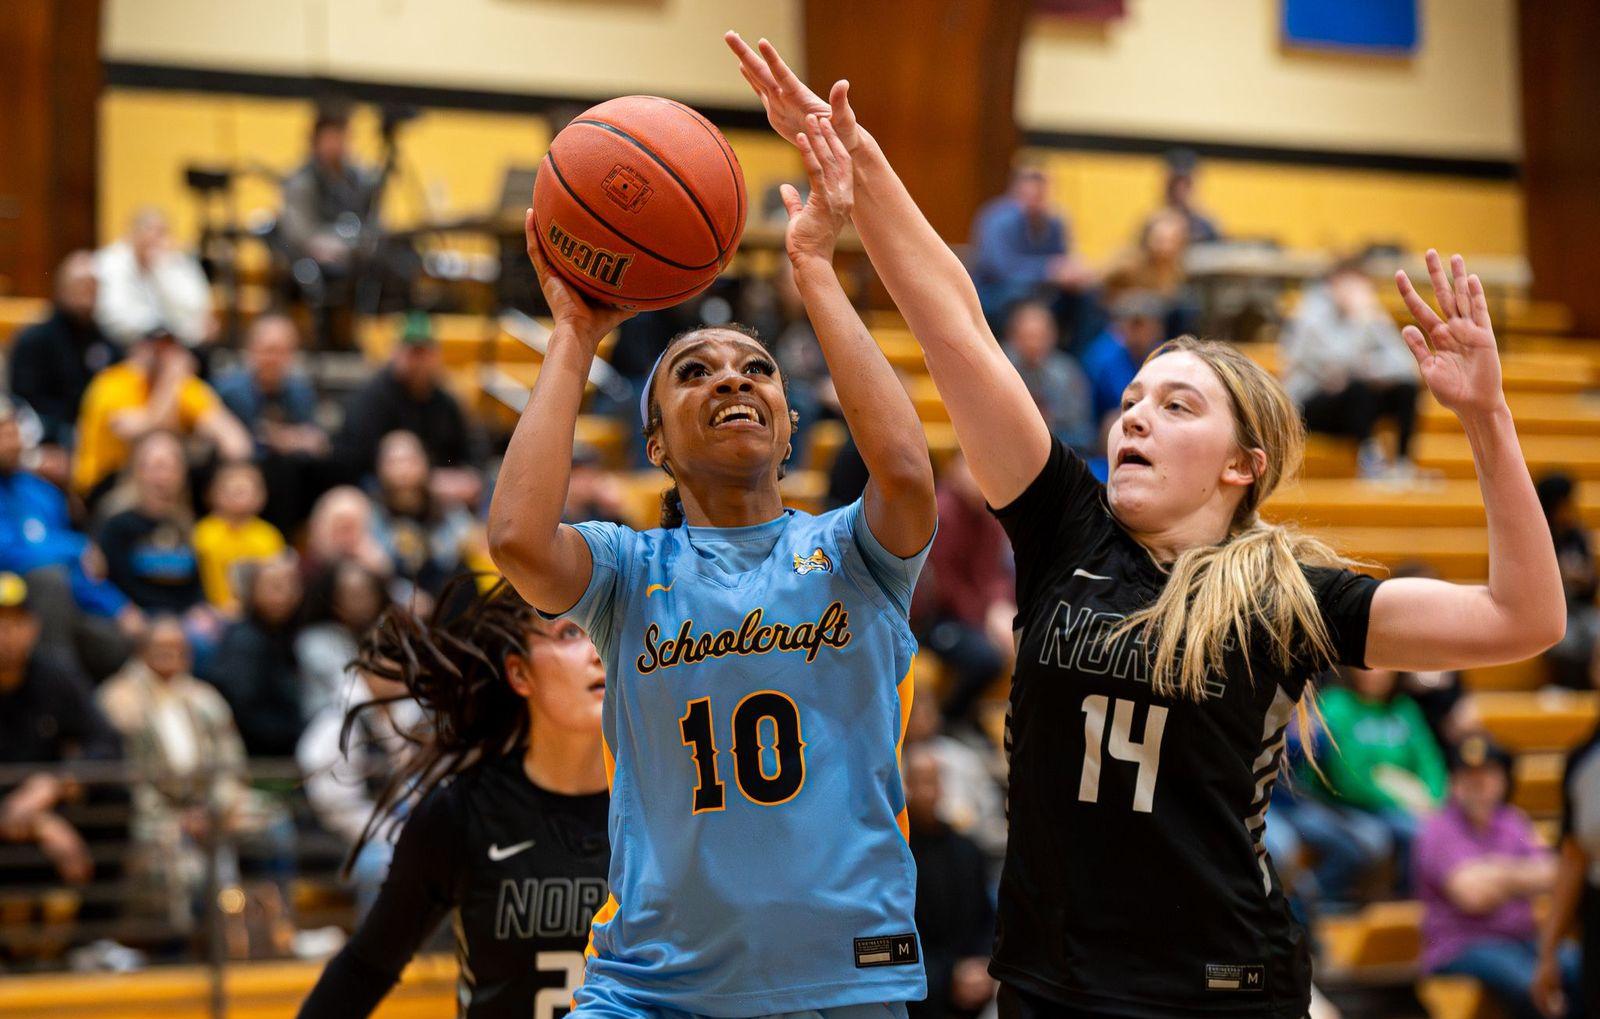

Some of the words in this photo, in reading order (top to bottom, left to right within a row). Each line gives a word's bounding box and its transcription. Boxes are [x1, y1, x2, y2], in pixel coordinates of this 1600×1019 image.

[548, 221, 632, 288] NJCAA
[636, 600, 852, 675] Schoolcraft
[1038, 600, 1236, 699] NOR
[678, 689, 807, 816] 10
[1078, 694, 1169, 813] 14
[898, 942, 910, 956] M
[1247, 972, 1259, 985] M
